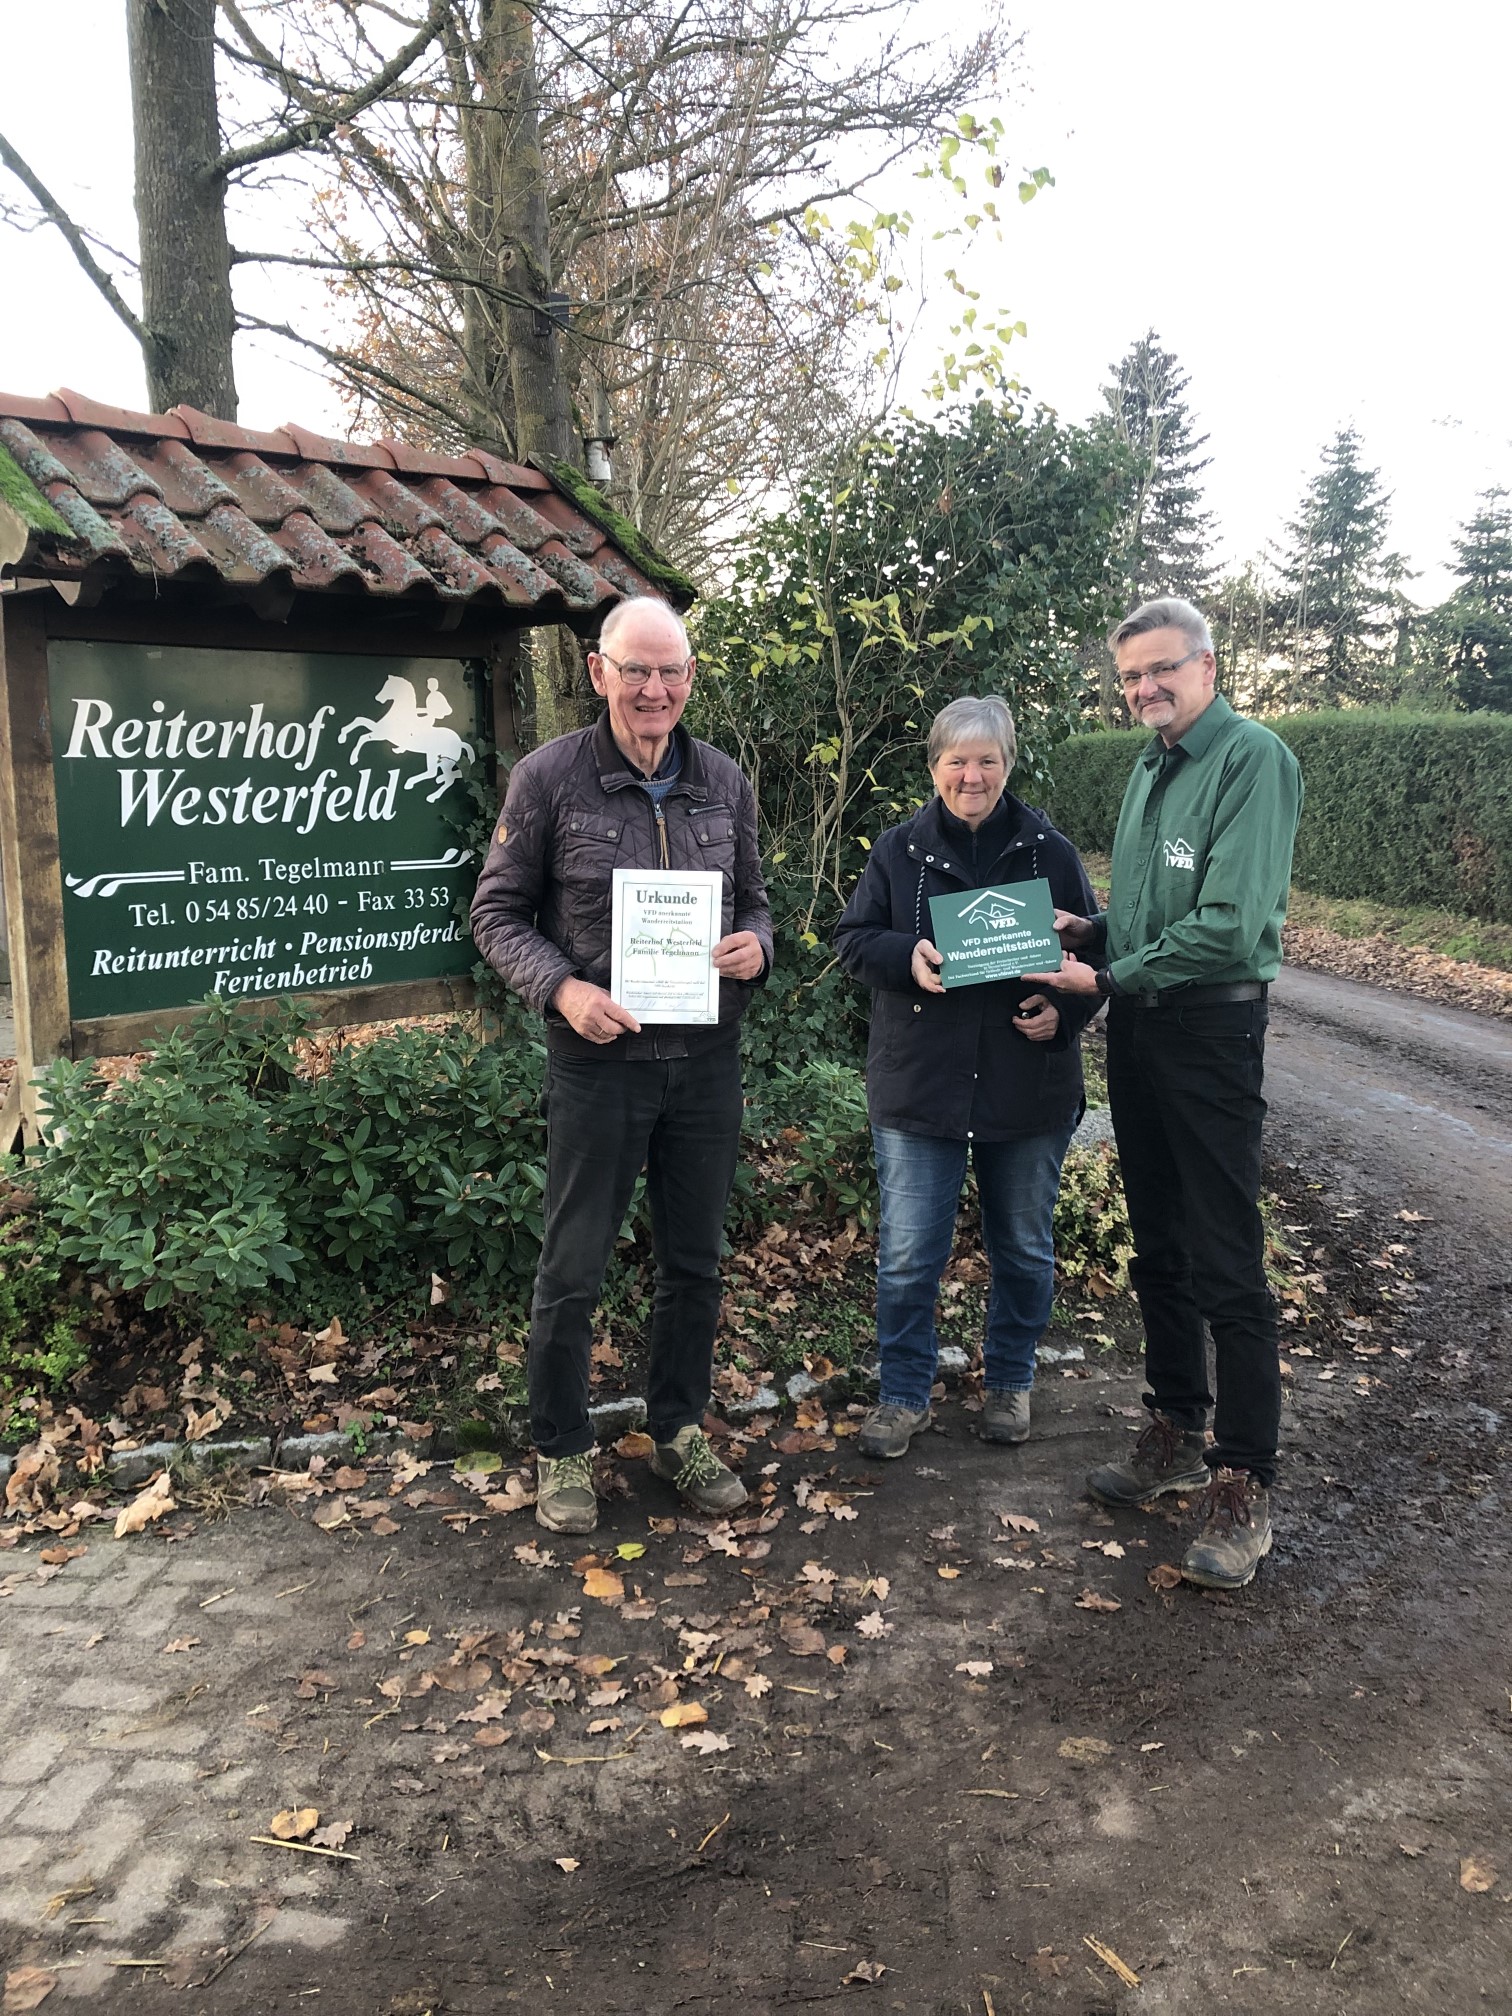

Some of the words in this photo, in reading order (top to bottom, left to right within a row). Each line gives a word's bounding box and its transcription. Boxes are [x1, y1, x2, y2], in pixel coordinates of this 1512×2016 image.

[62, 697, 336, 772] Reiterhof
[116, 768, 401, 835] Westerfeld
[187, 861, 250, 885] Fam.
[258, 856, 385, 885] Tegelmann
[128, 902, 176, 928] Tel.
[357, 890, 396, 912] Fax
[636, 889, 698, 905] Urkunde
[90, 935, 277, 976] Reitunterricht
[947, 938, 1051, 962] Wanderreitstation
[961, 937, 981, 948] VFD
[982, 930, 1032, 944] anerkannte
[213, 956, 373, 995] Ferienbetrieb
